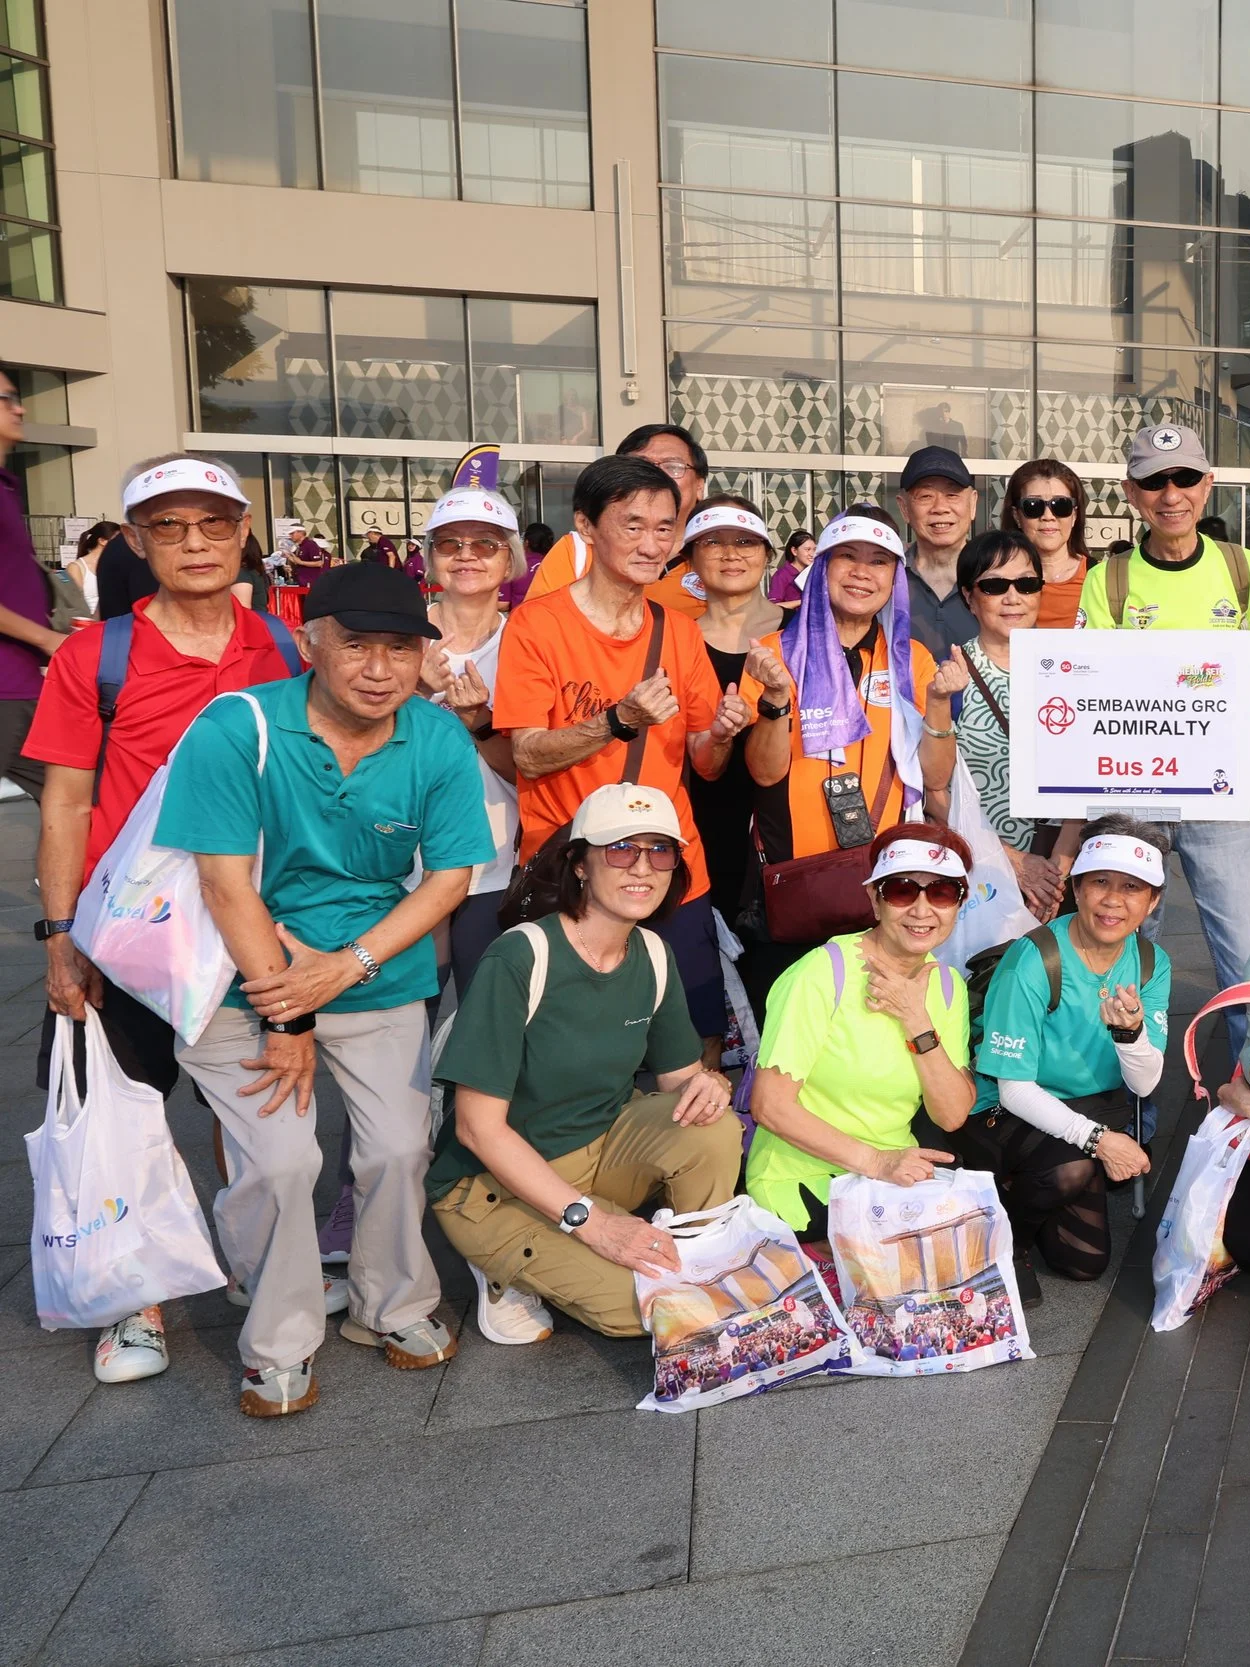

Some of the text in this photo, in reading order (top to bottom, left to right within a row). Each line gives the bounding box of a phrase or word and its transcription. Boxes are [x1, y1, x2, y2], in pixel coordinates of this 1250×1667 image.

[361, 510, 424, 526] GUC
[1083, 526, 1121, 540] CCI
[800, 707, 833, 720] ares
[1076, 699, 1227, 713] SEMBAWANG GRC
[1093, 720, 1211, 736] ADMIRALTY
[1097, 756, 1179, 776] Bus 24
[990, 1031, 1026, 1050] Sport
[42, 1234, 77, 1248] WTS
